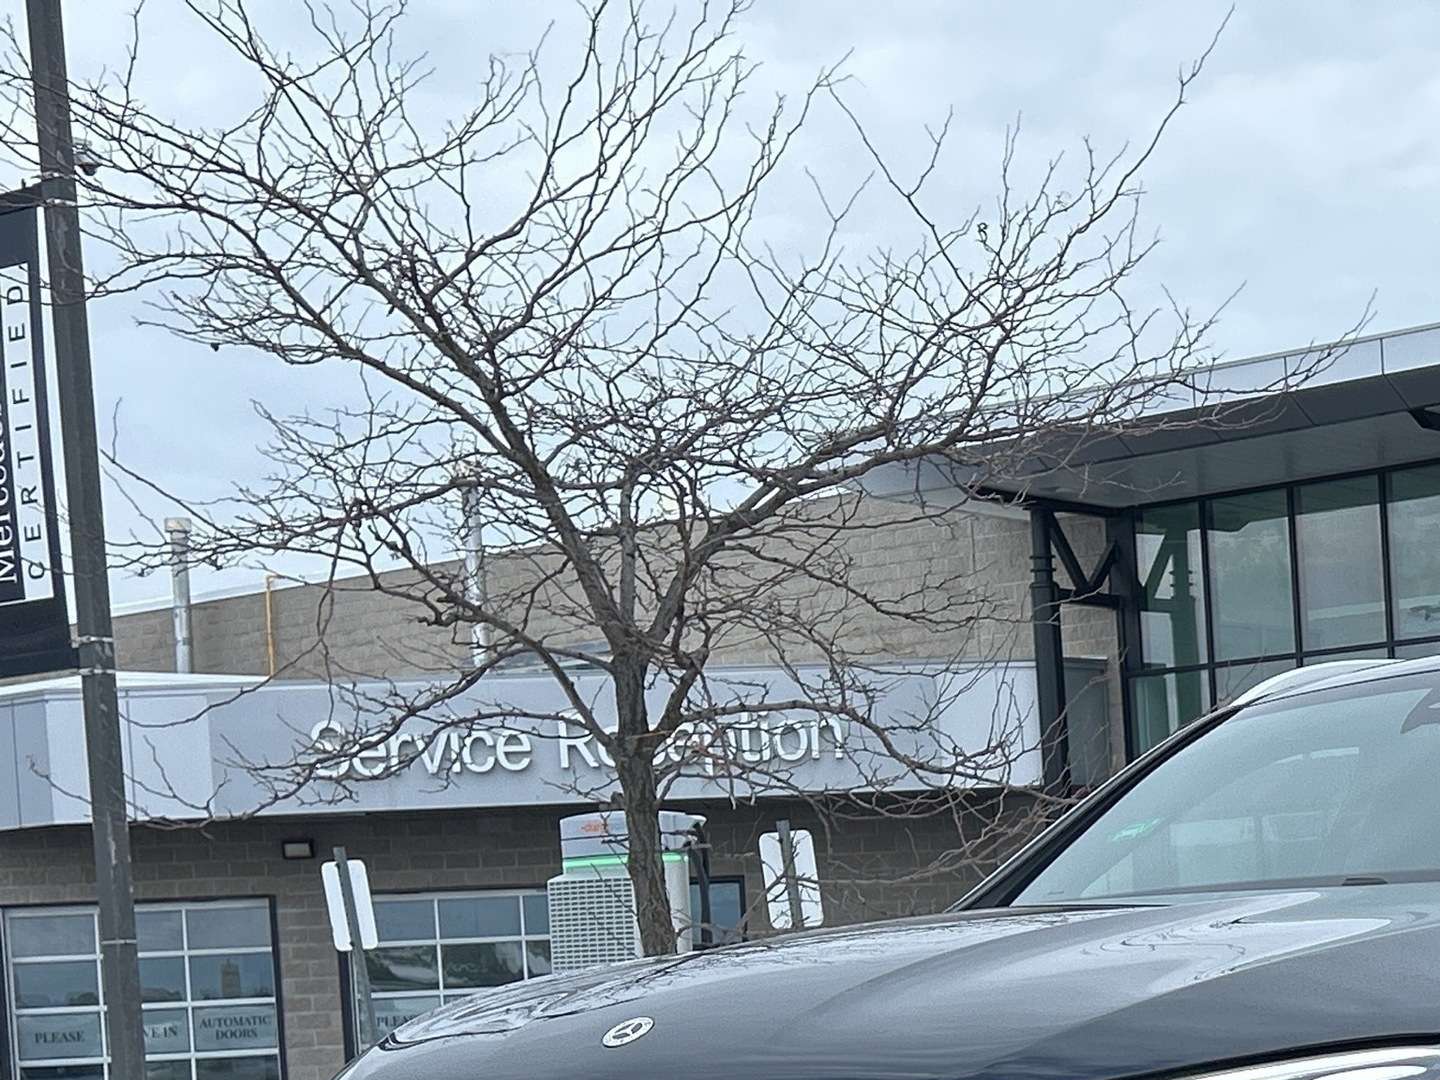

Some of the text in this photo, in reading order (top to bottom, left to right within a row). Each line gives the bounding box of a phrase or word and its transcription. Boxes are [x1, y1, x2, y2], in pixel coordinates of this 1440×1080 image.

[7, 286, 45, 580] CERTIFIED
[311, 718, 532, 778] Service
[200, 1016, 273, 1029] AUTOMATIC
[35, 1031, 86, 1044] PLEASE
[216, 1028, 258, 1041] DOORS
